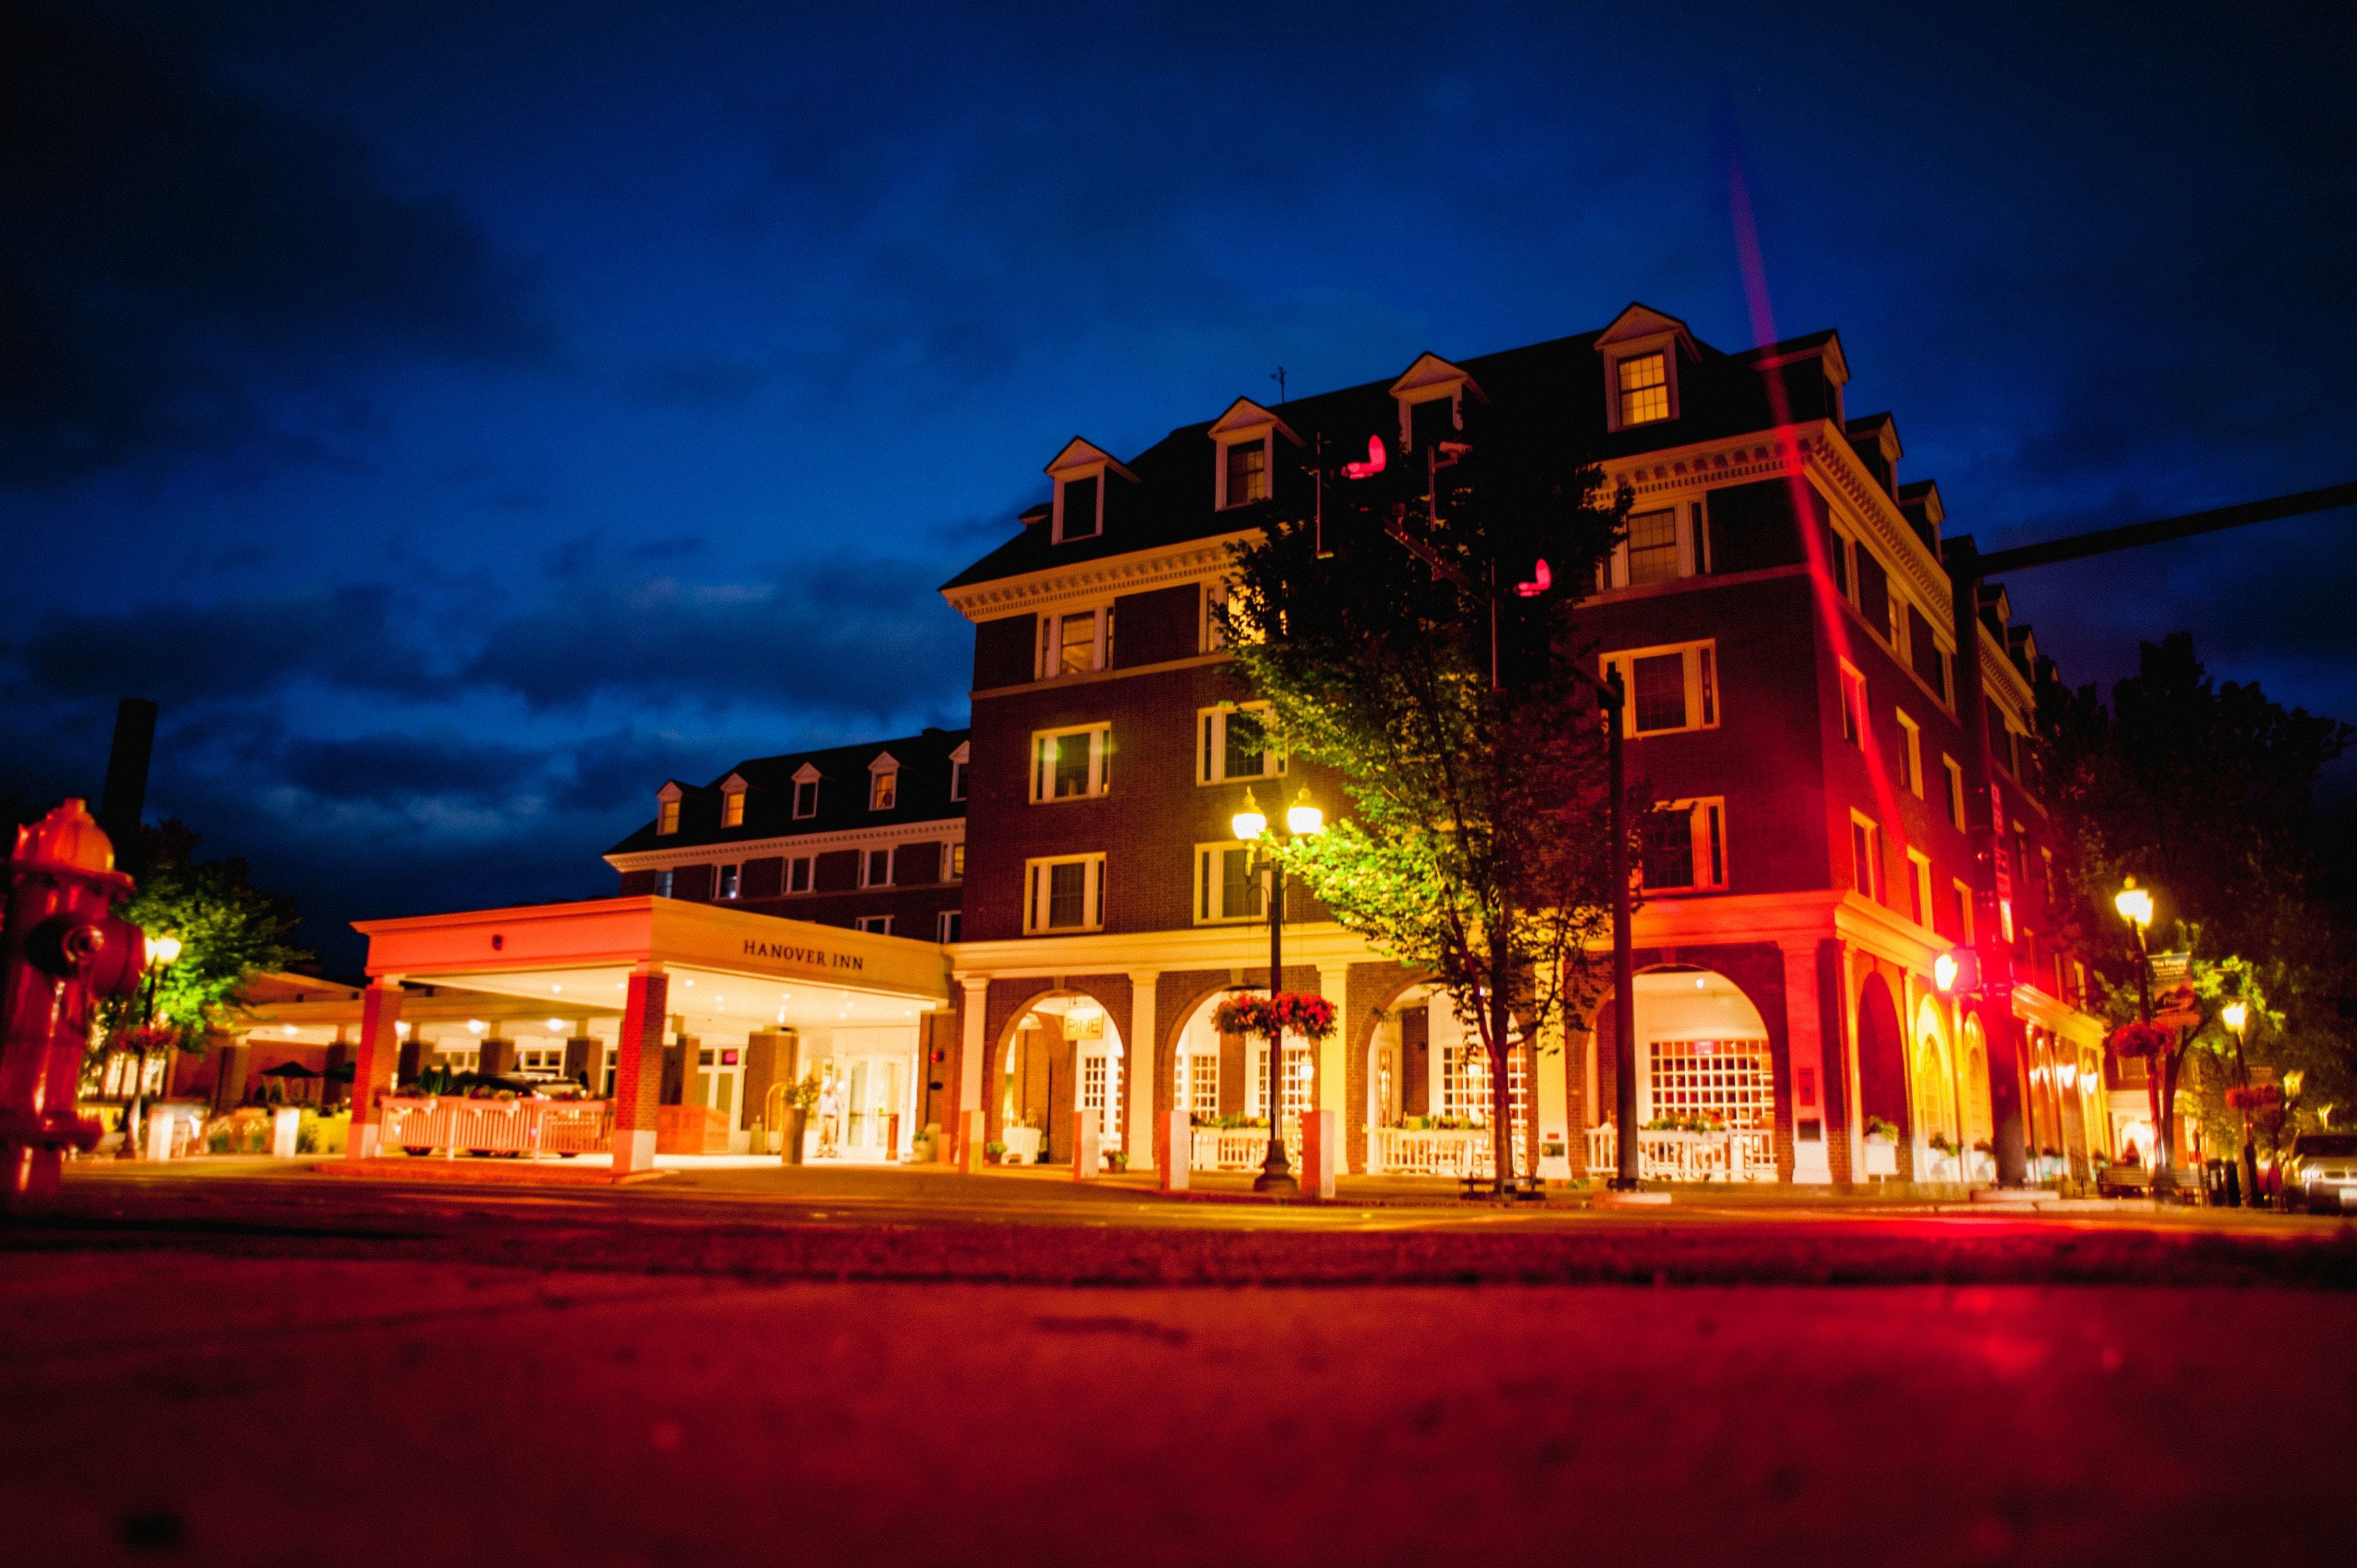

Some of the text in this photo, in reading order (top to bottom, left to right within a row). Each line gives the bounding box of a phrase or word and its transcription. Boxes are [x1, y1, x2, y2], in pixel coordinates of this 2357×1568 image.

[743, 940, 863, 969] HANOVER INN
[1067, 1017, 1100, 1033] PINE
